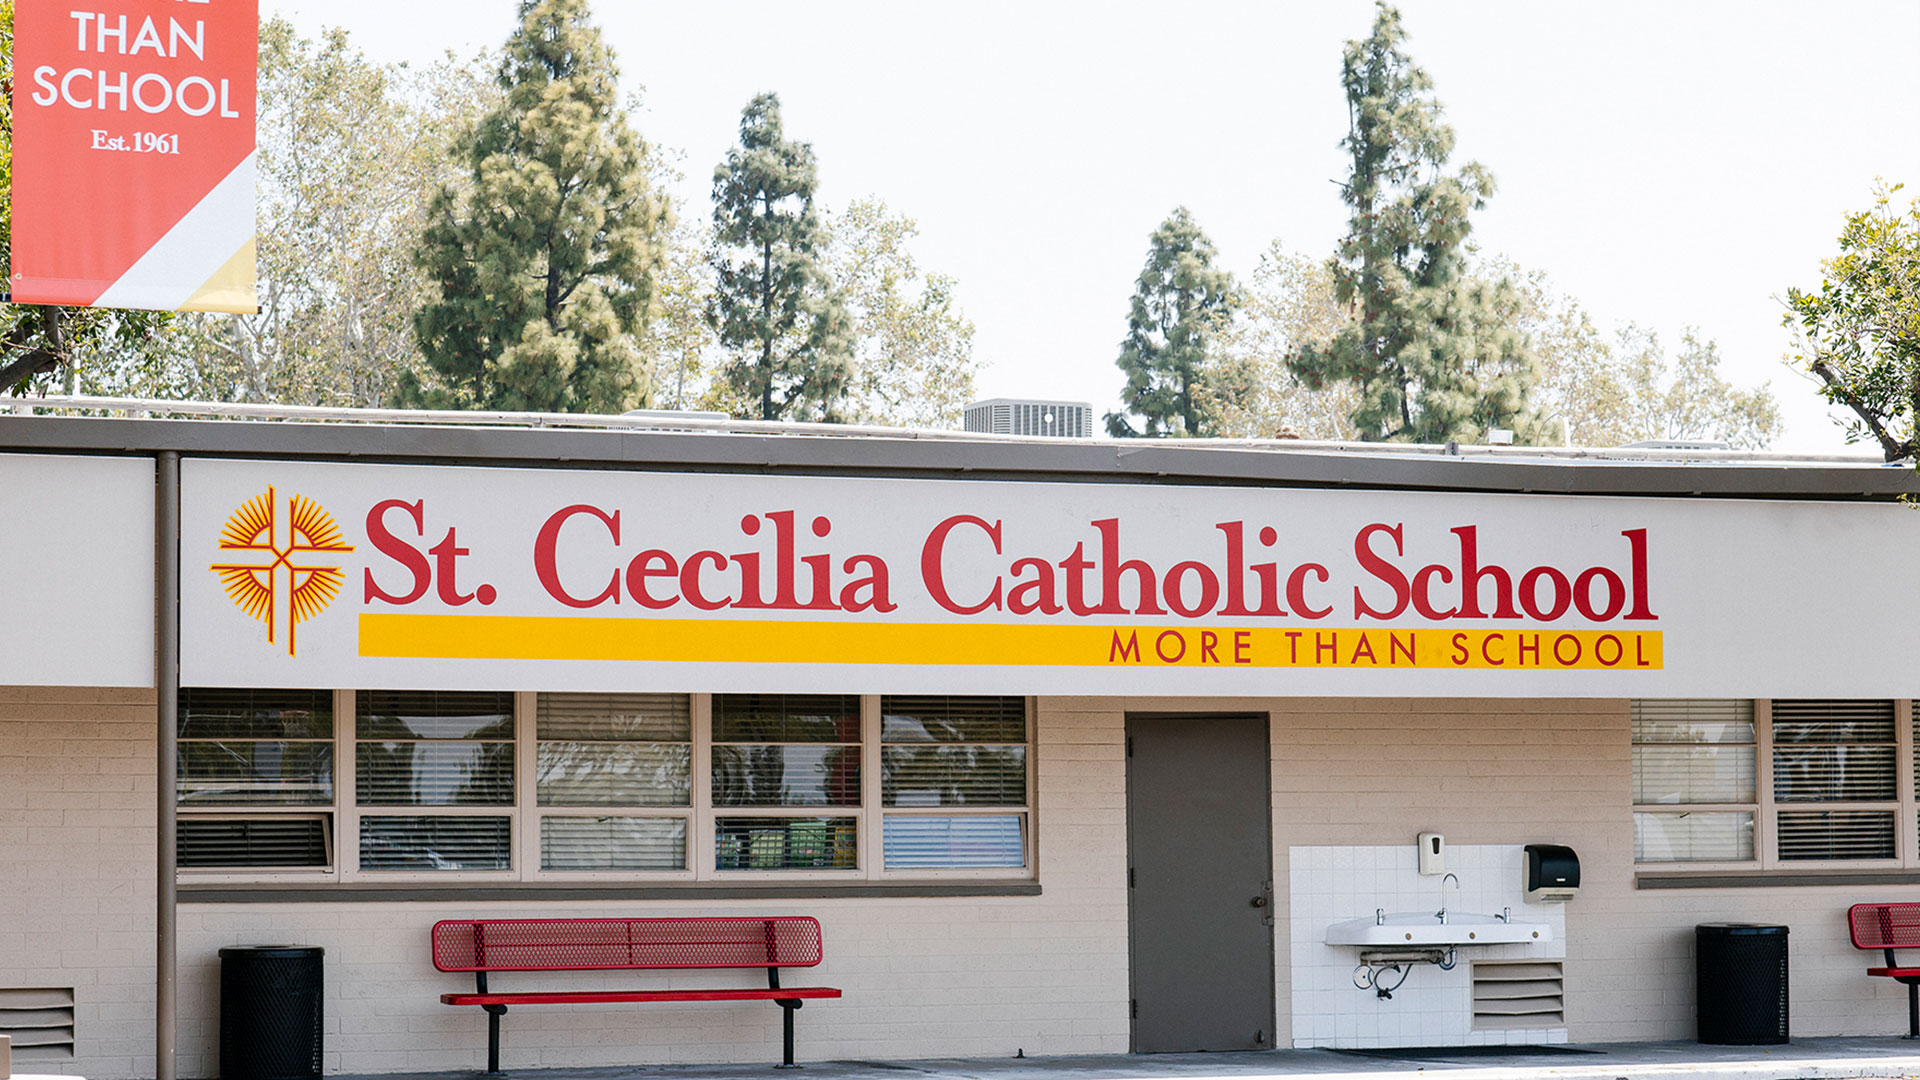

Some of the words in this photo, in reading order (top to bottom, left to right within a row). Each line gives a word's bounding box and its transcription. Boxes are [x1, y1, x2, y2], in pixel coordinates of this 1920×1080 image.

[70, 11, 205, 61] THAN
[31, 65, 239, 118] SCHOOL
[364, 498, 497, 607] St.
[533, 504, 898, 613] Cecilia
[920, 514, 1334, 620] Catholic
[1353, 522, 1659, 623] School
[1108, 629, 1252, 664] MORE
[1284, 631, 1417, 666] THAN
[1450, 632, 1650, 667] SCHOOL
